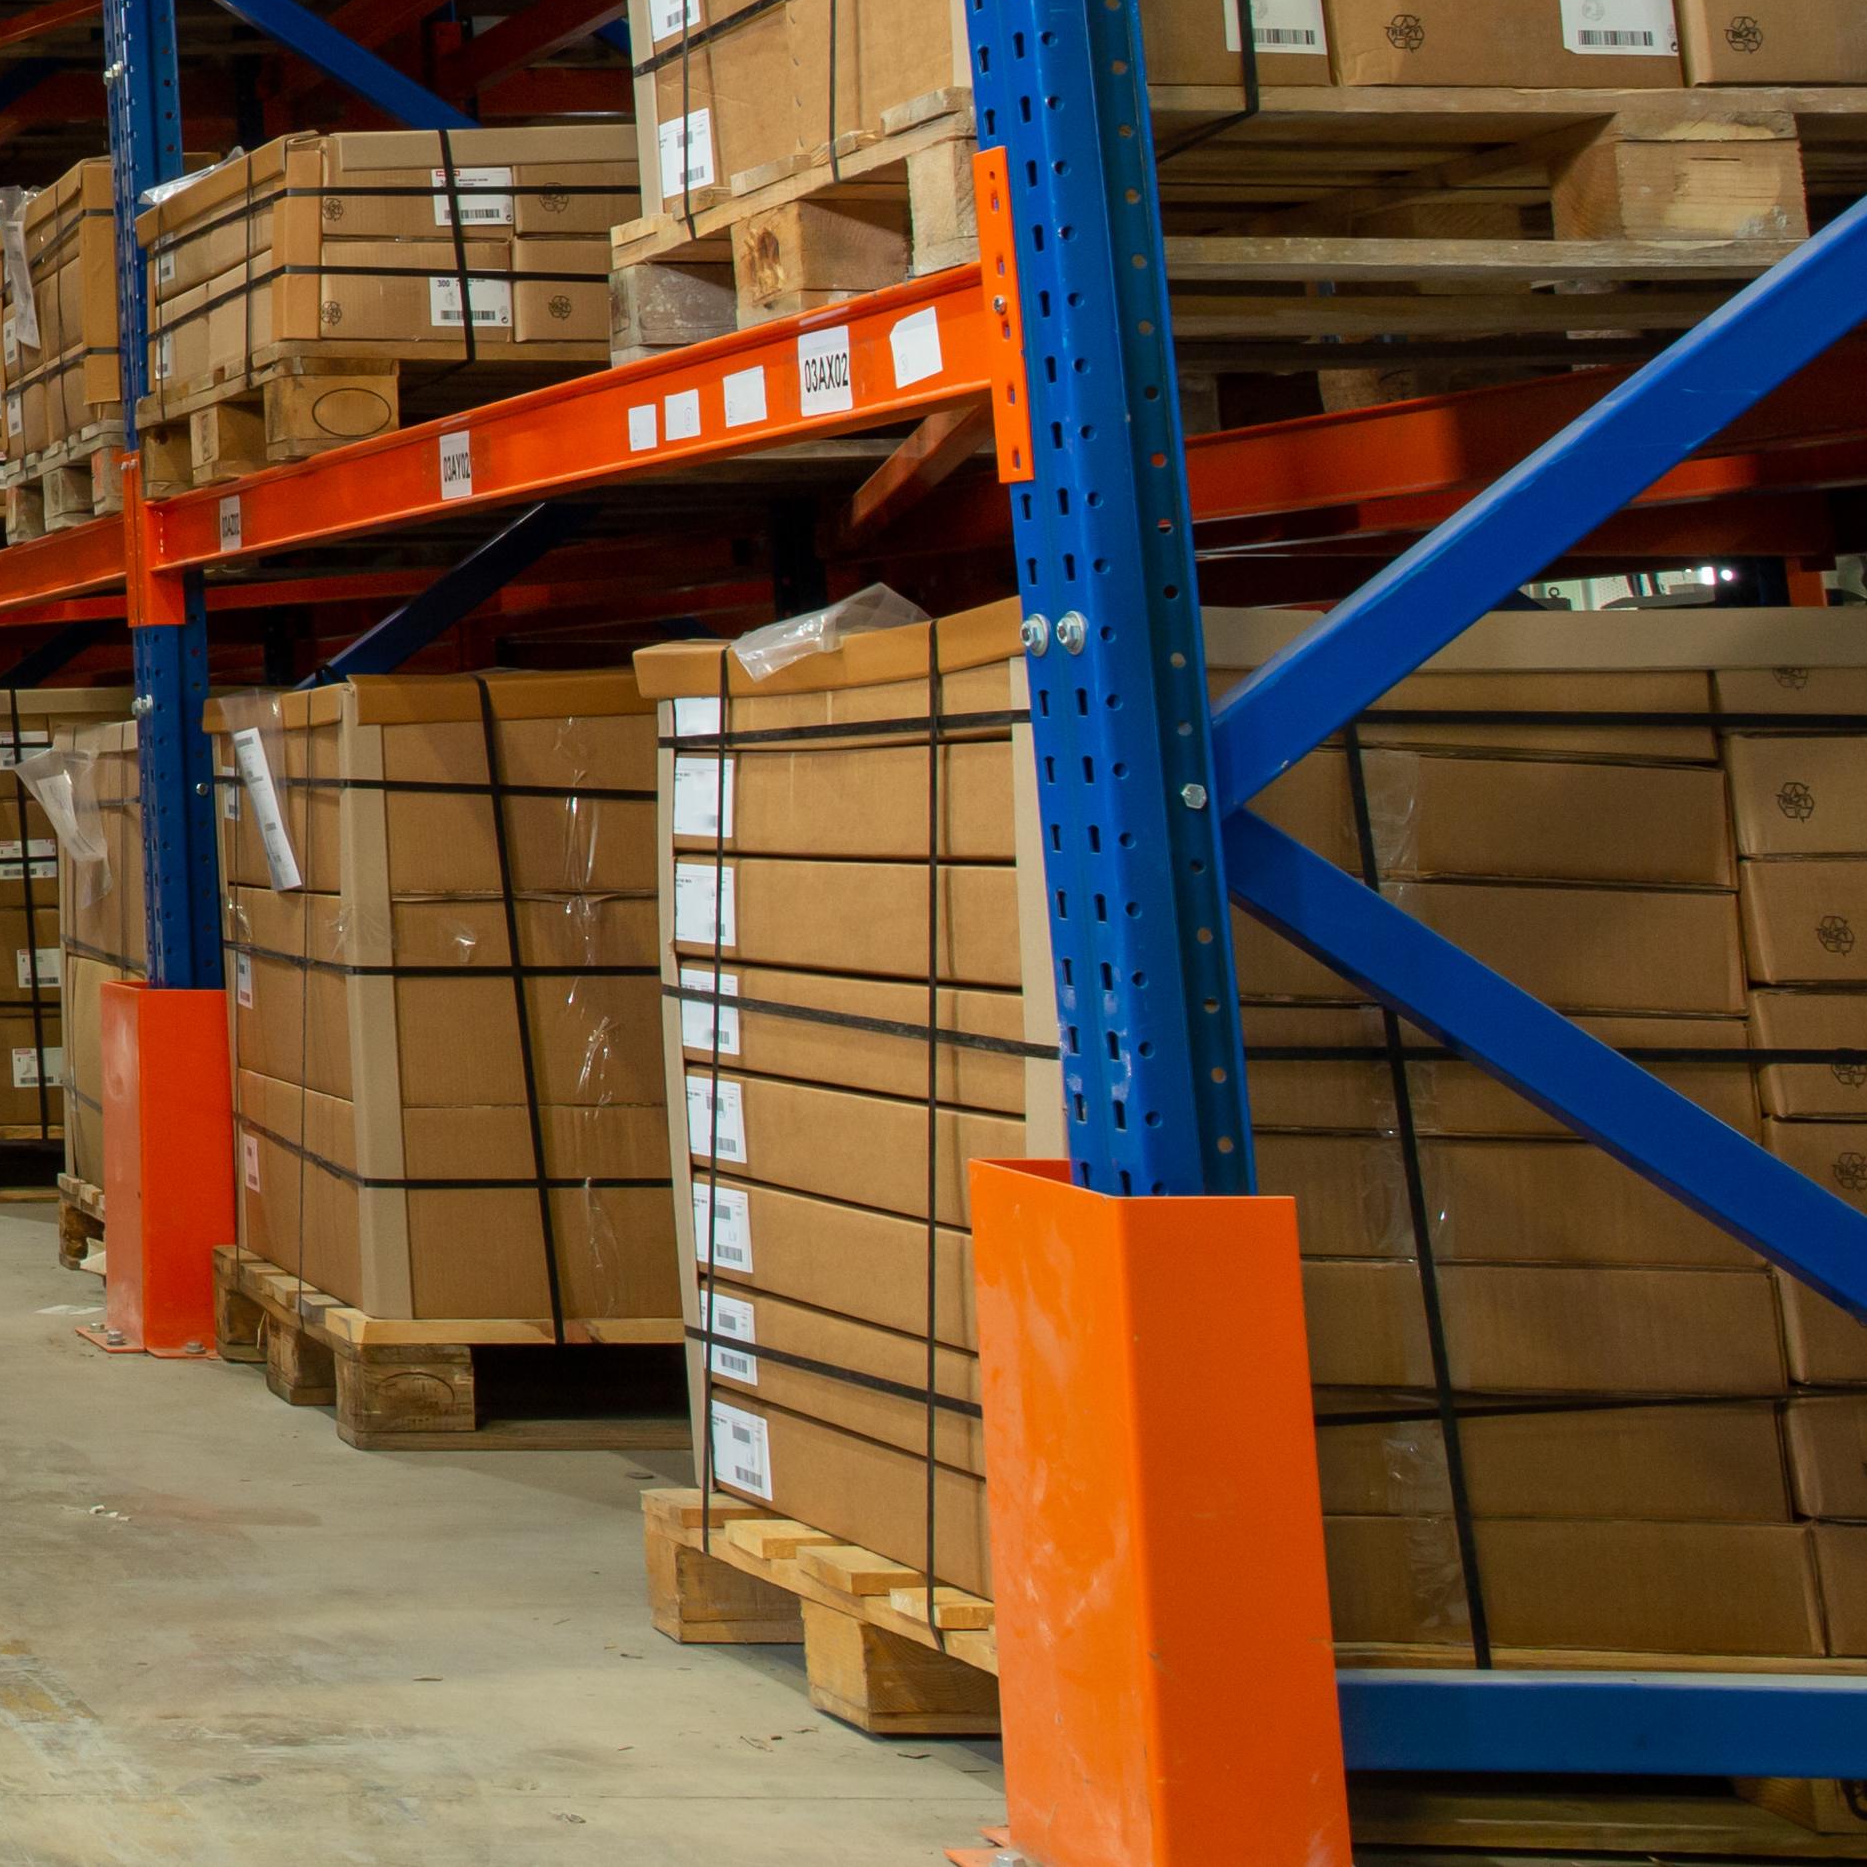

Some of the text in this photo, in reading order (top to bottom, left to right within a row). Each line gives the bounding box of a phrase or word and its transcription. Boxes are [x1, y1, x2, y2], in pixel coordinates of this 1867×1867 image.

[437, 279, 451, 288] 300
[804, 352, 849, 393] 03AX02
[443, 451, 471, 483] 03AY02
